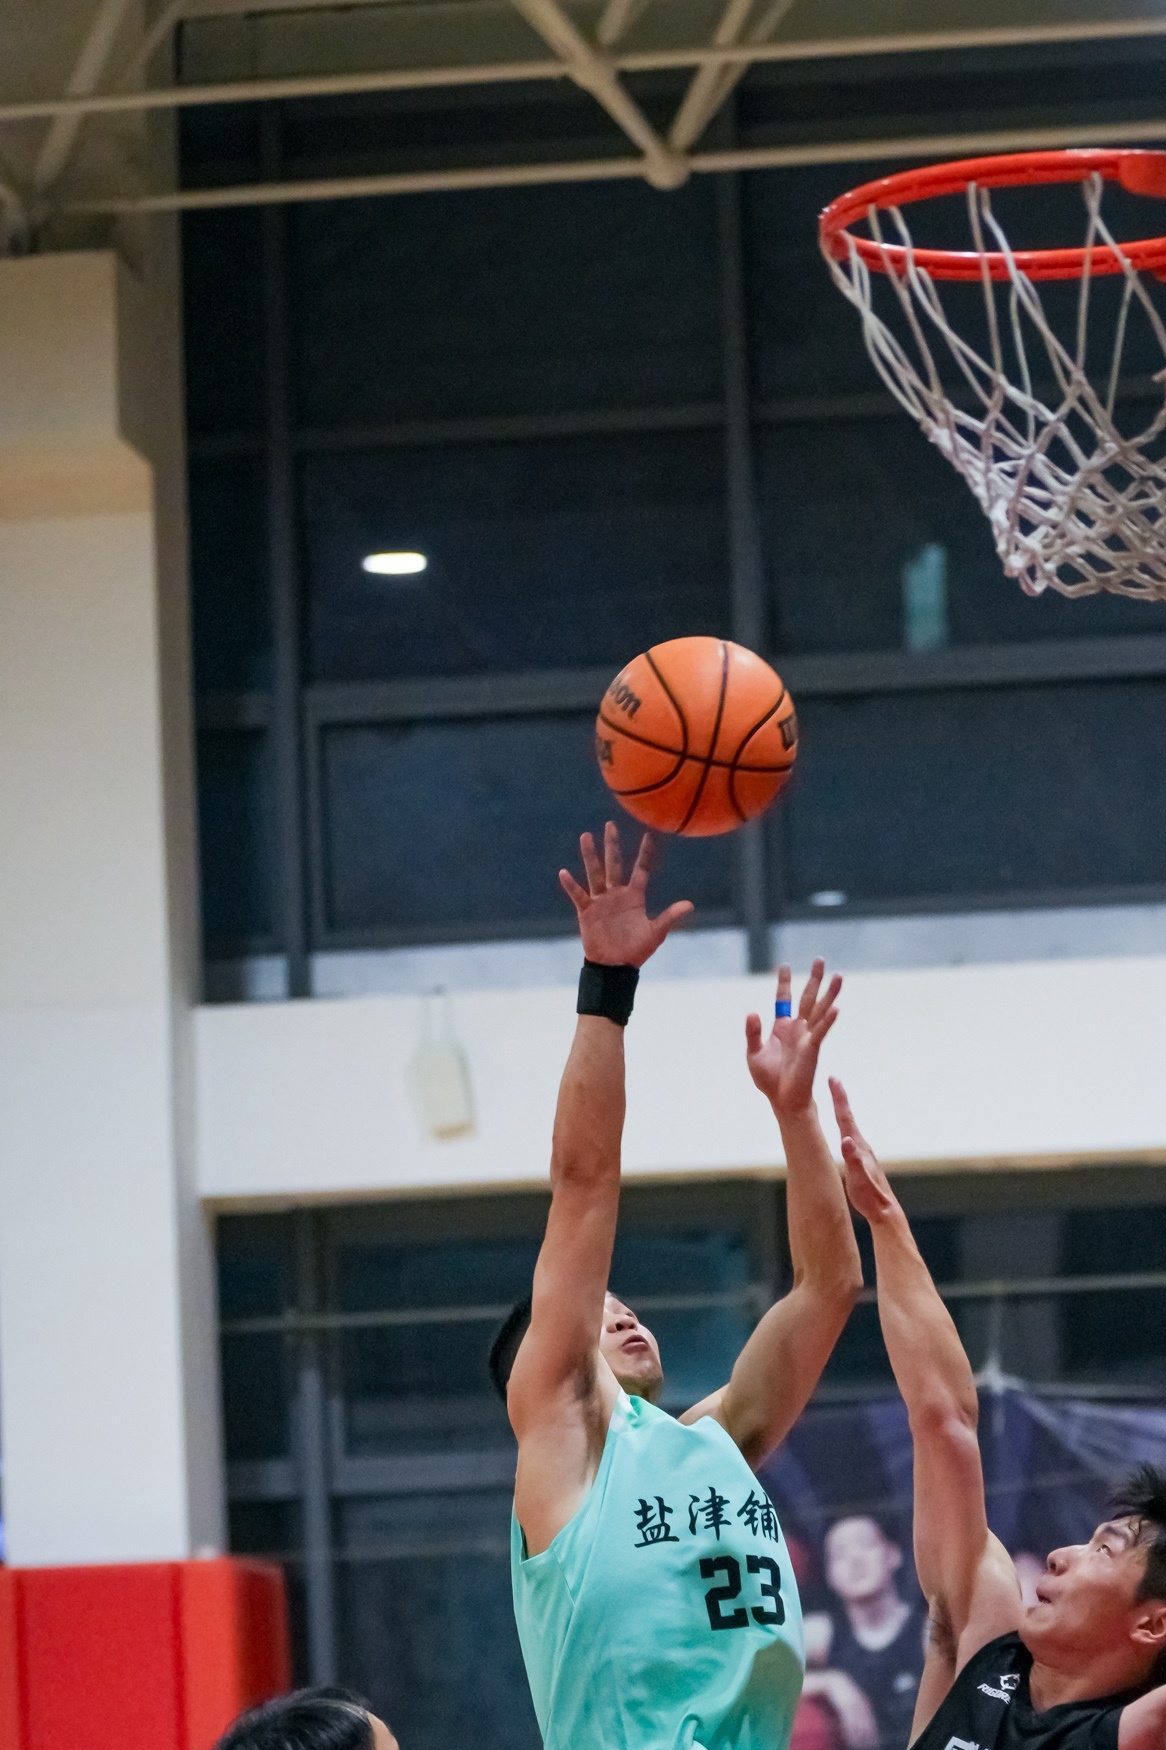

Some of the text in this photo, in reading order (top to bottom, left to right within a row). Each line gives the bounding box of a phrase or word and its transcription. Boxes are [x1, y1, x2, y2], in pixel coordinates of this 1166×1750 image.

[634, 1486, 780, 1548] 盐津铺
[698, 1554, 786, 1631] 23
